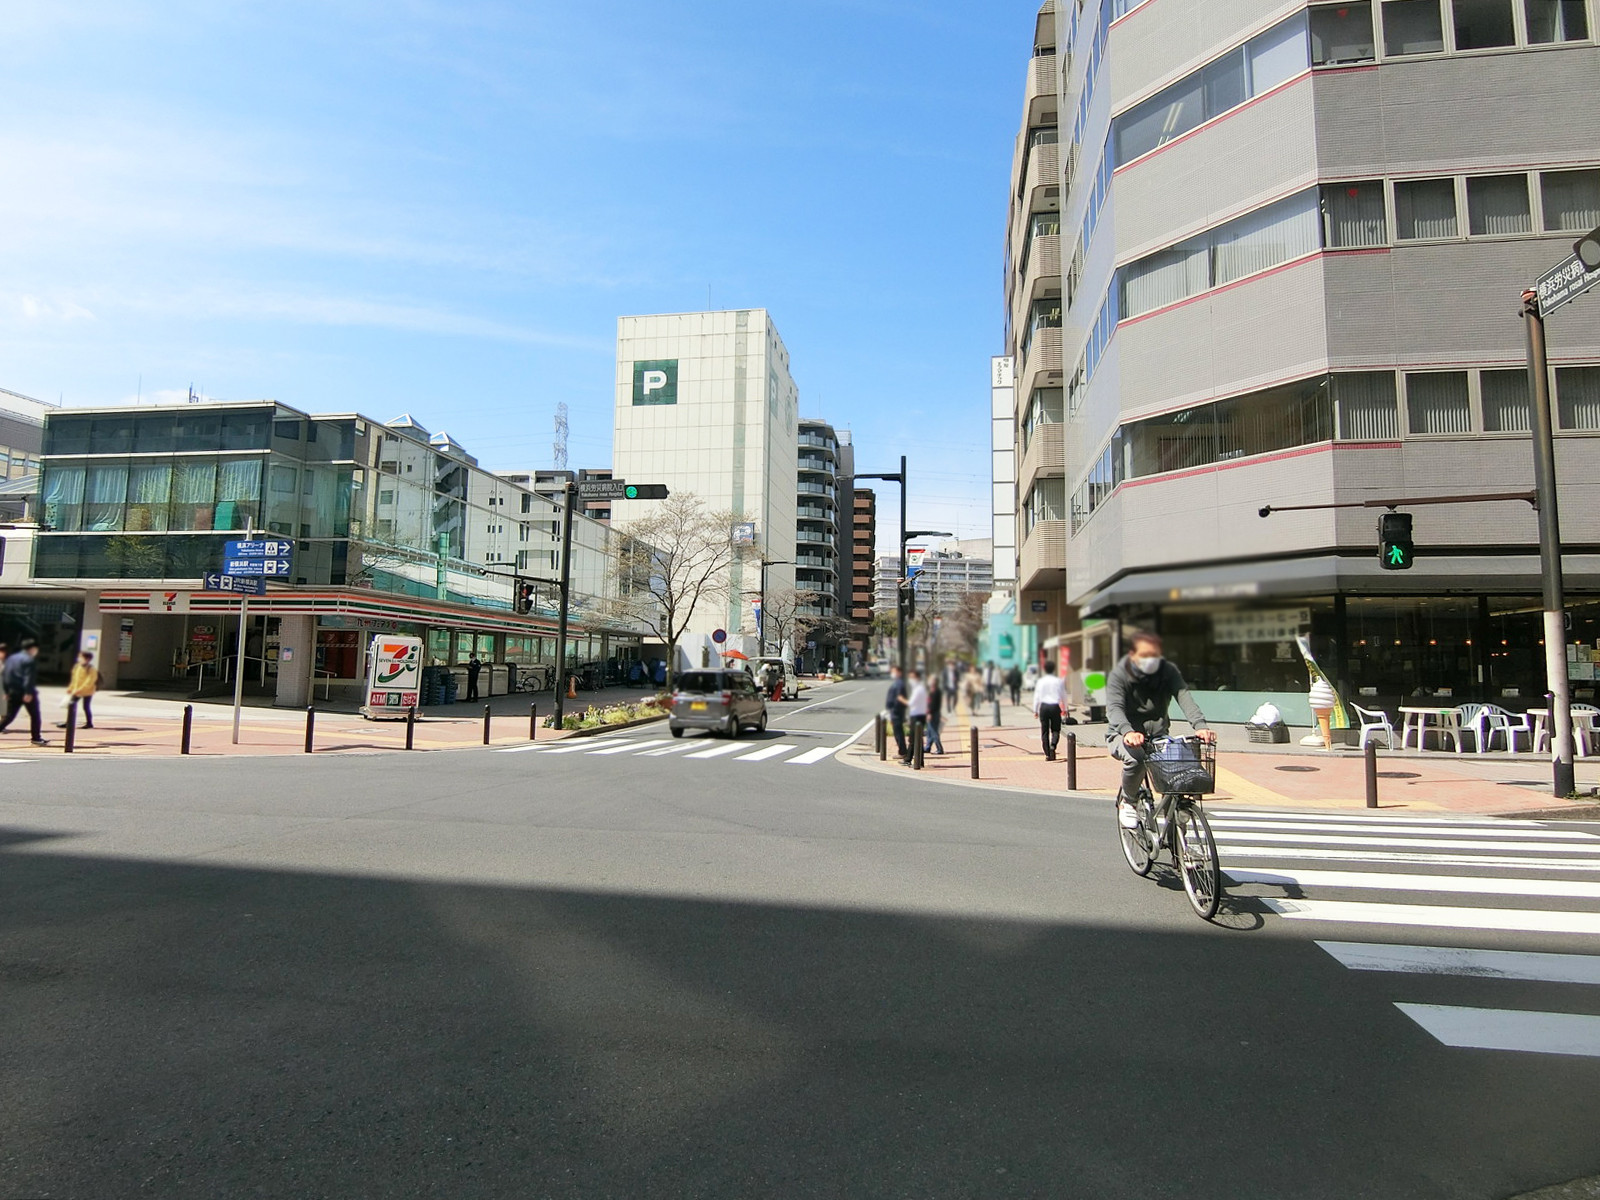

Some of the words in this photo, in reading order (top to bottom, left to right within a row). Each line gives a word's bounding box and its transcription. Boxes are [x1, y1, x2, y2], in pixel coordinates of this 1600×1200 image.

[1541, 288, 1569, 309] Yokohama
[643, 370, 668, 395] P
[371, 694, 386, 704] ATM
[402, 694, 417, 705] たばこ
